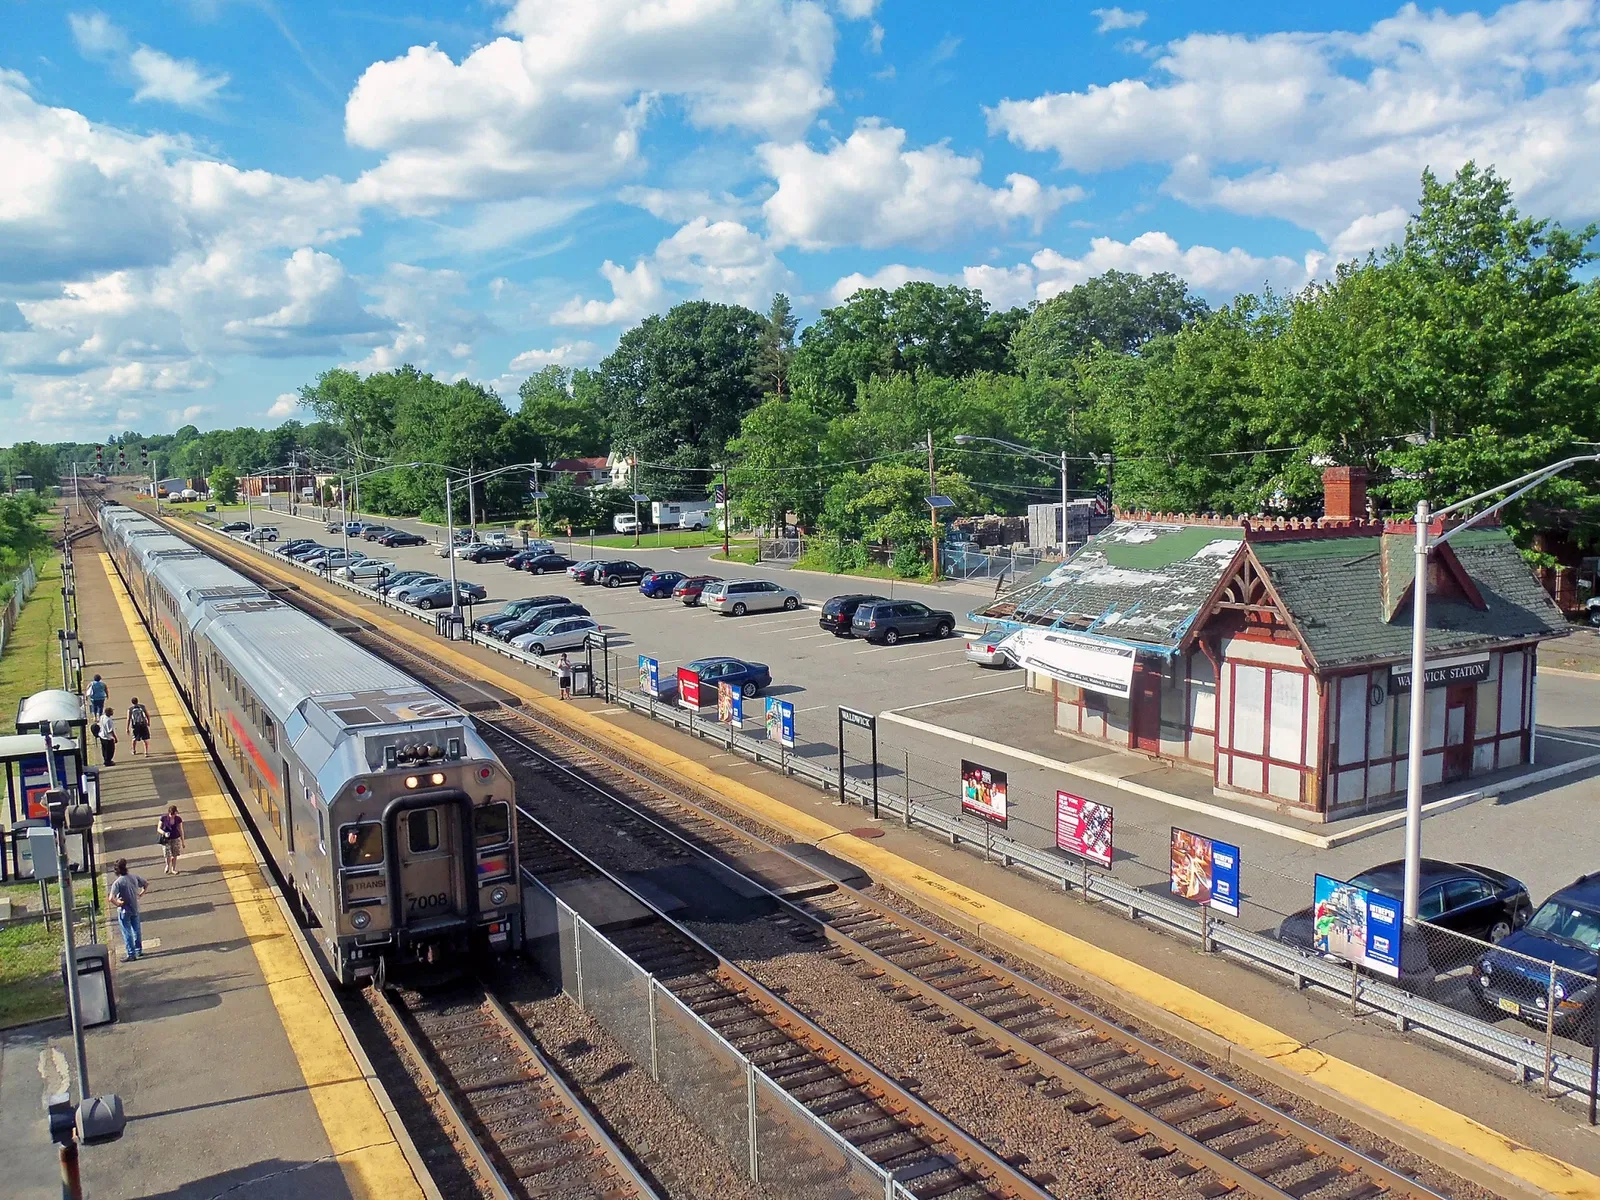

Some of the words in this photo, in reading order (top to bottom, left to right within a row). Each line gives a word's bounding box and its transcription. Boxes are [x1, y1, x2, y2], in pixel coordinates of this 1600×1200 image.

[1398, 670, 1446, 687] WAWICK
[1450, 663, 1485, 679] STATION
[355, 880, 386, 890] TRANSI
[408, 892, 448, 910] 7008
